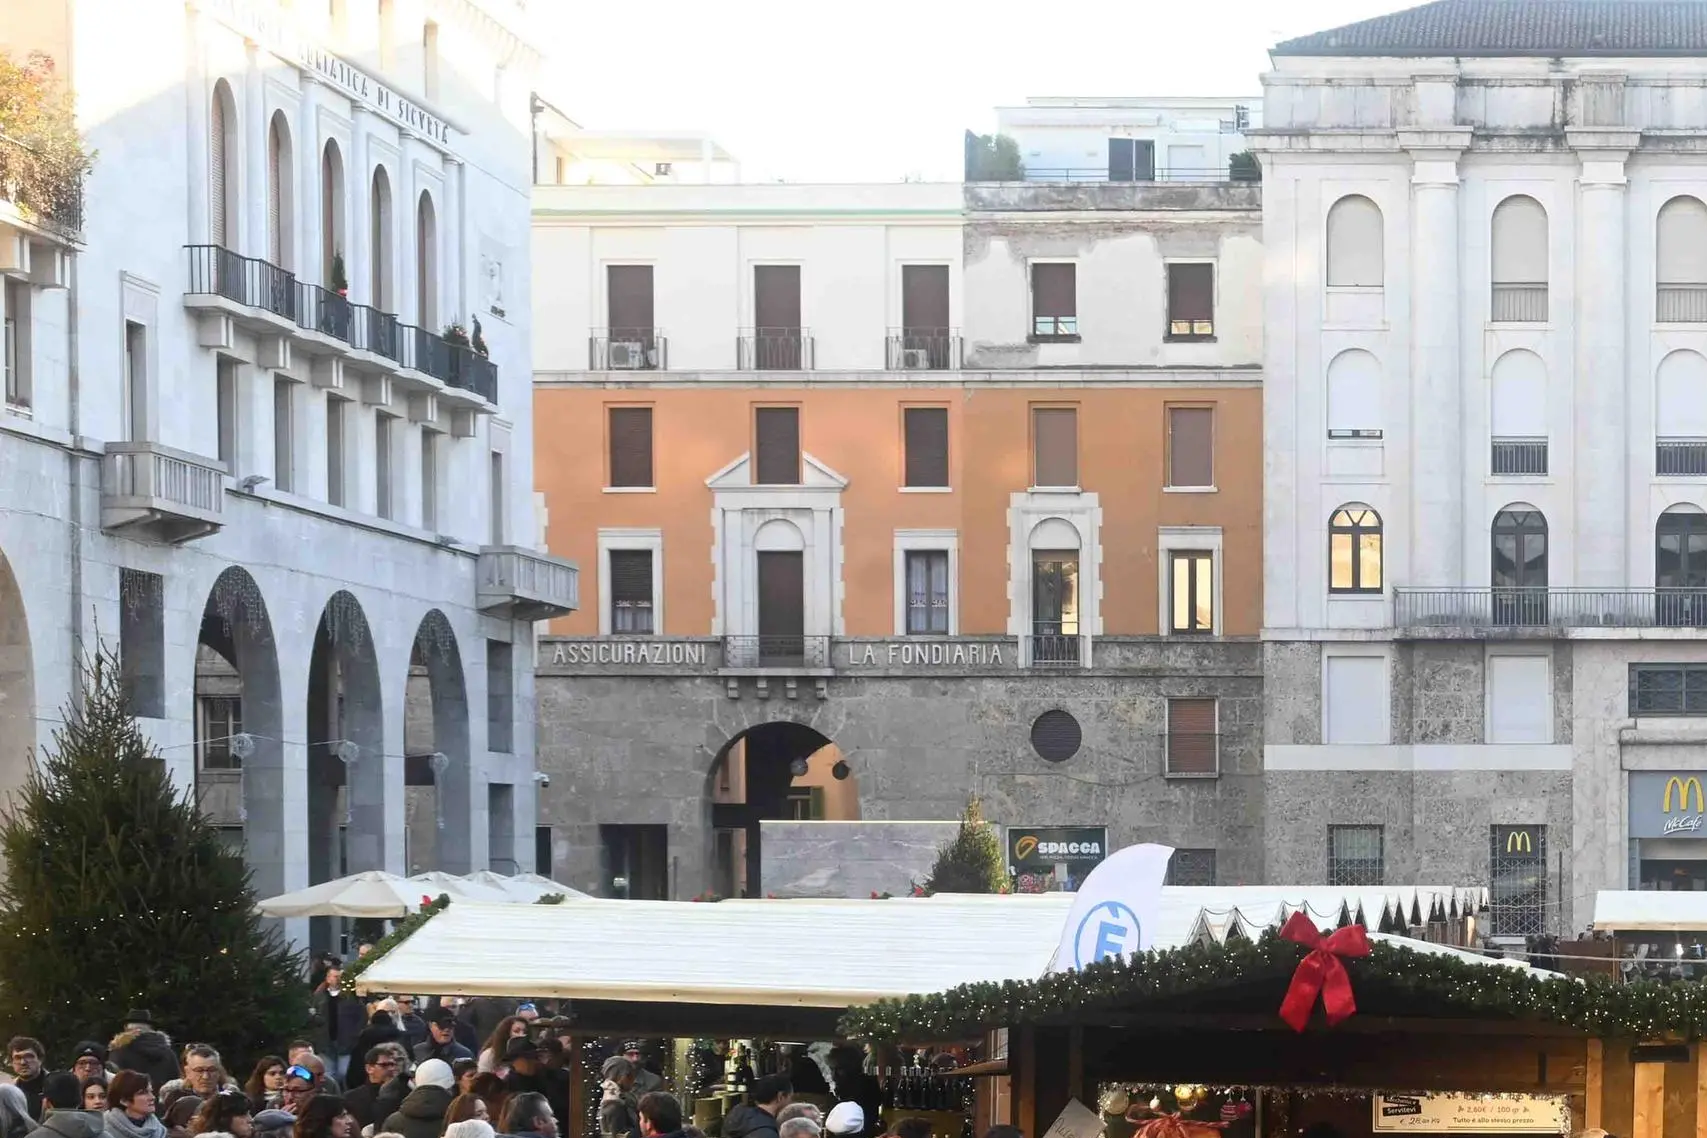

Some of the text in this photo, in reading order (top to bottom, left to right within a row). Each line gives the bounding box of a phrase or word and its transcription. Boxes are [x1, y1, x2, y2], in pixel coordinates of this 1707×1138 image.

[377, 85, 389, 110] DI
[553, 643, 1002, 665] ASSICURAZIONI LA FONDIARIA
[1663, 815, 1703, 834] McCafé
[1038, 842, 1100, 854] SPACCA
